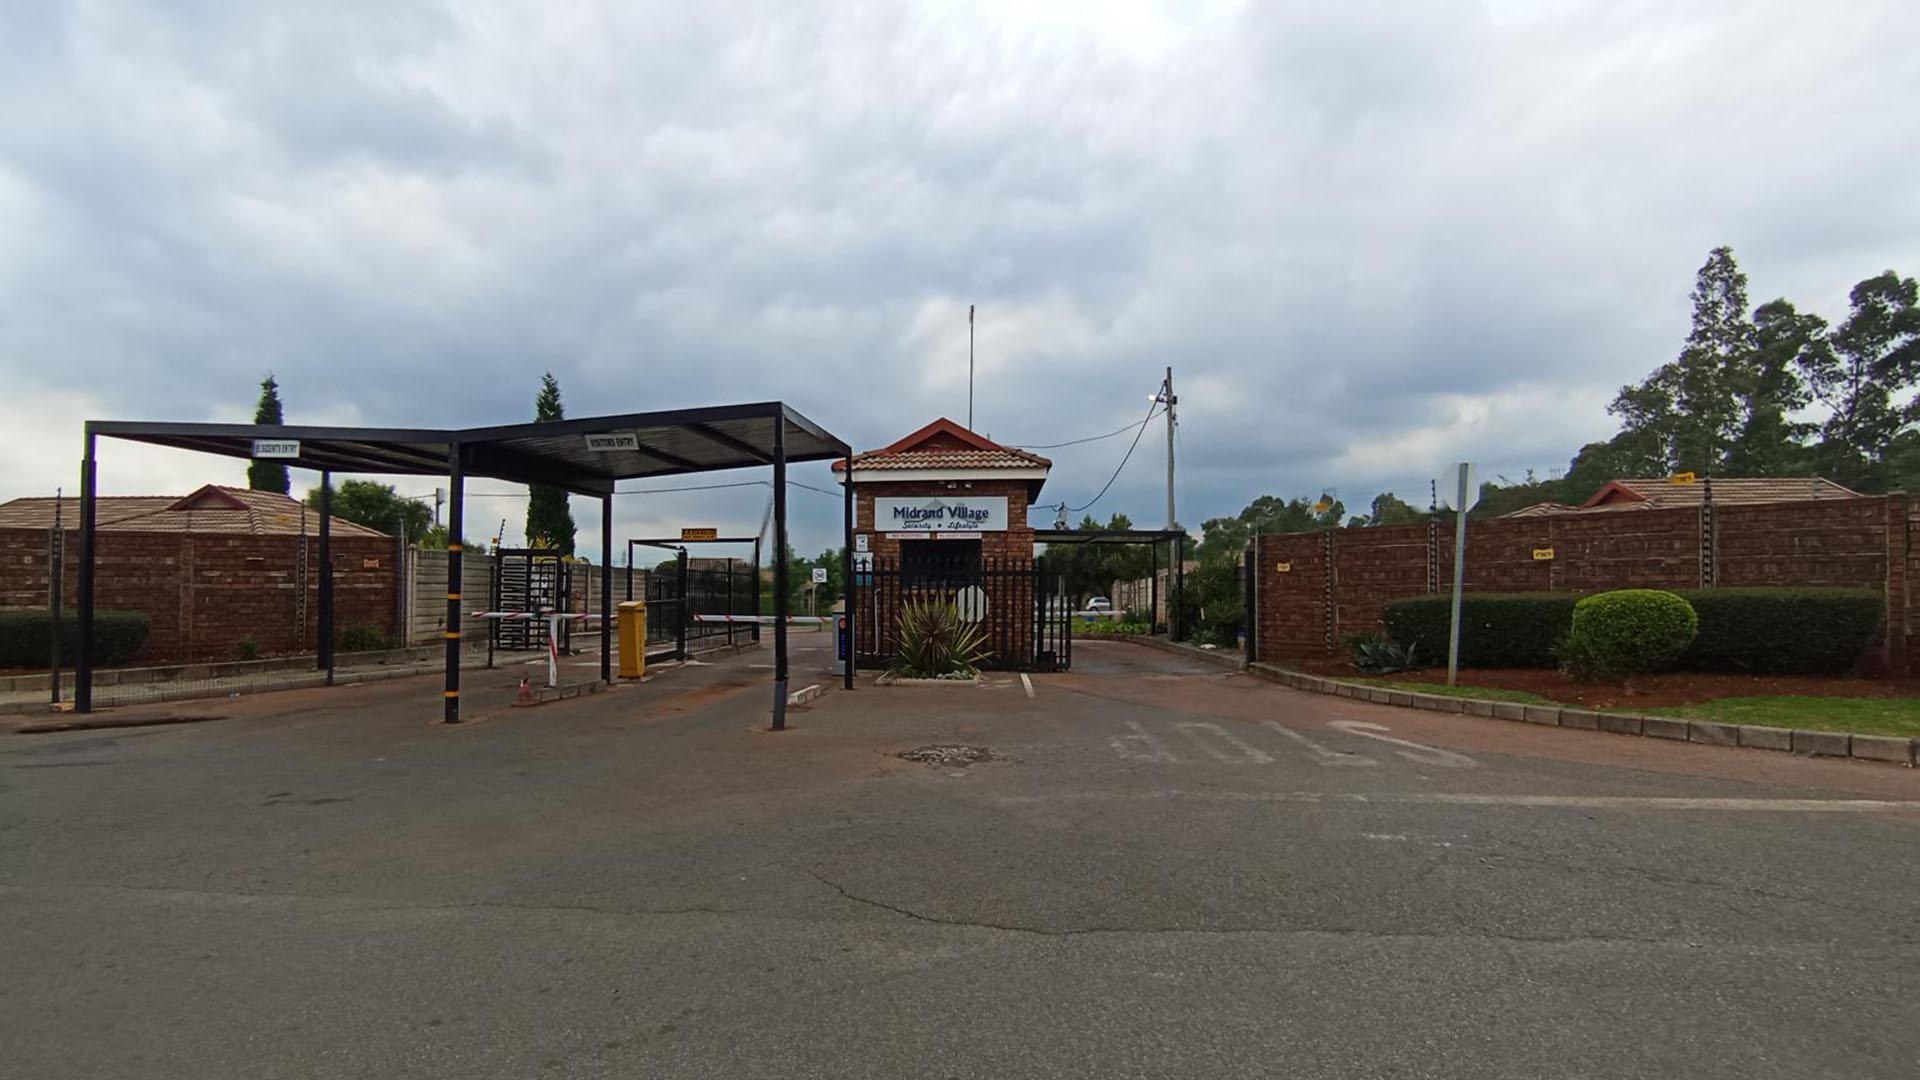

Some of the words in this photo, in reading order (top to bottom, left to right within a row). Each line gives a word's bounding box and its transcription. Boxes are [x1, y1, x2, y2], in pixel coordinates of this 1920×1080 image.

[615, 437, 634, 447] ENTRY
[893, 506, 944, 519] Midrand
[947, 506, 989, 520] Village
[902, 520, 932, 530] Security
[947, 520, 979, 530] Lifestyle
